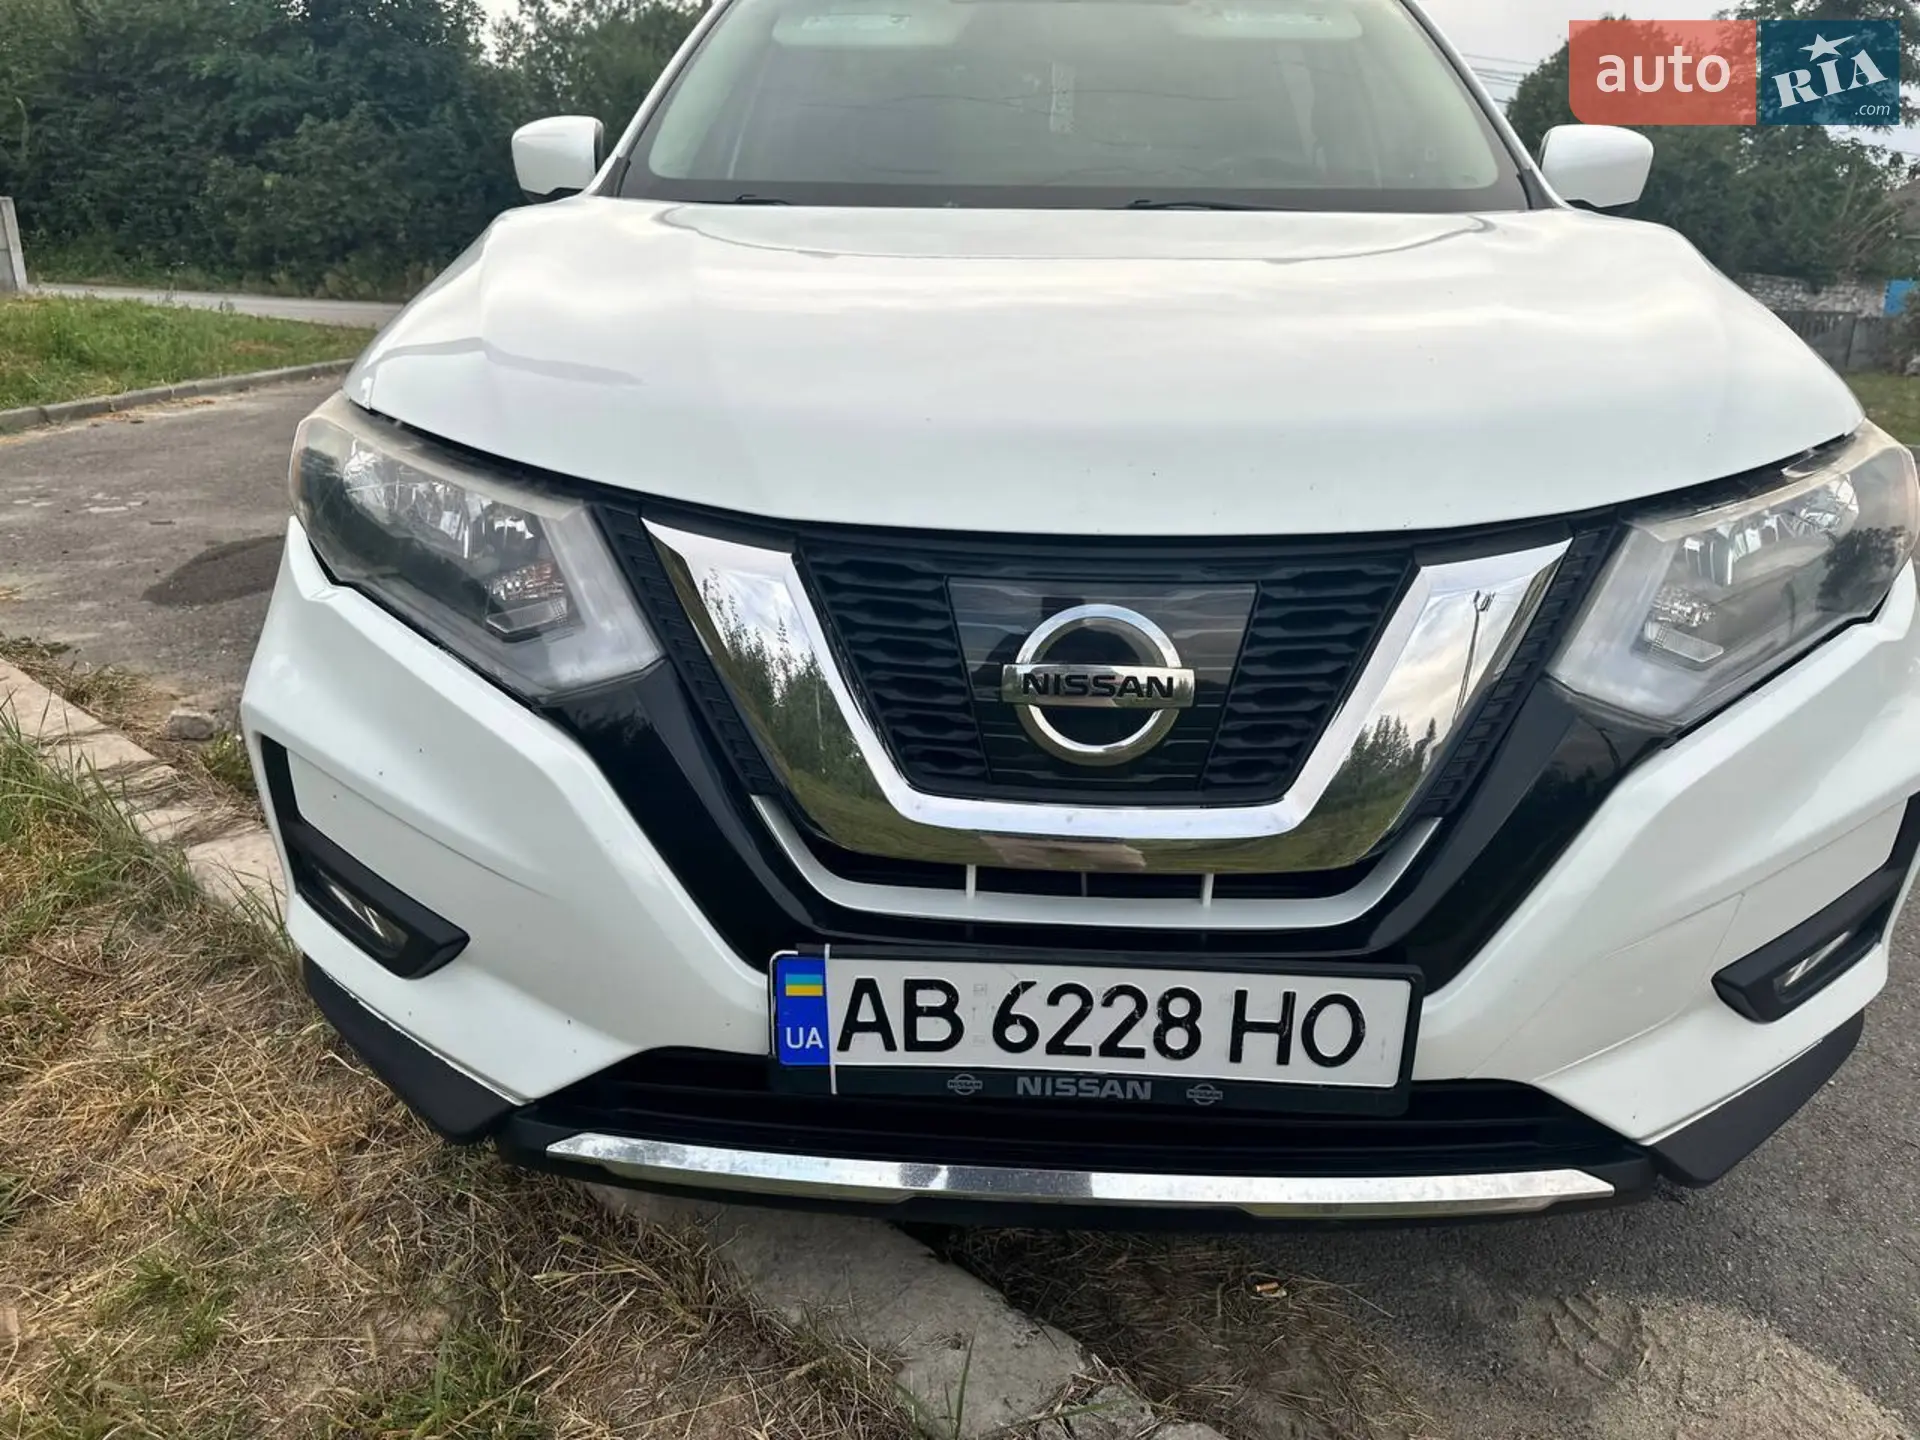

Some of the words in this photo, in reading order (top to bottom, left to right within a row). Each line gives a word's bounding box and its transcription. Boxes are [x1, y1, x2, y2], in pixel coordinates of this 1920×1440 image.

[1022, 673, 1174, 698] NISSAN
[837, 977, 965, 1052] AB
[993, 980, 1202, 1060] 6228
[1229, 989, 1366, 1068] HO
[785, 1026, 824, 1049] UA
[1016, 1076, 1152, 1100] NISSAN
